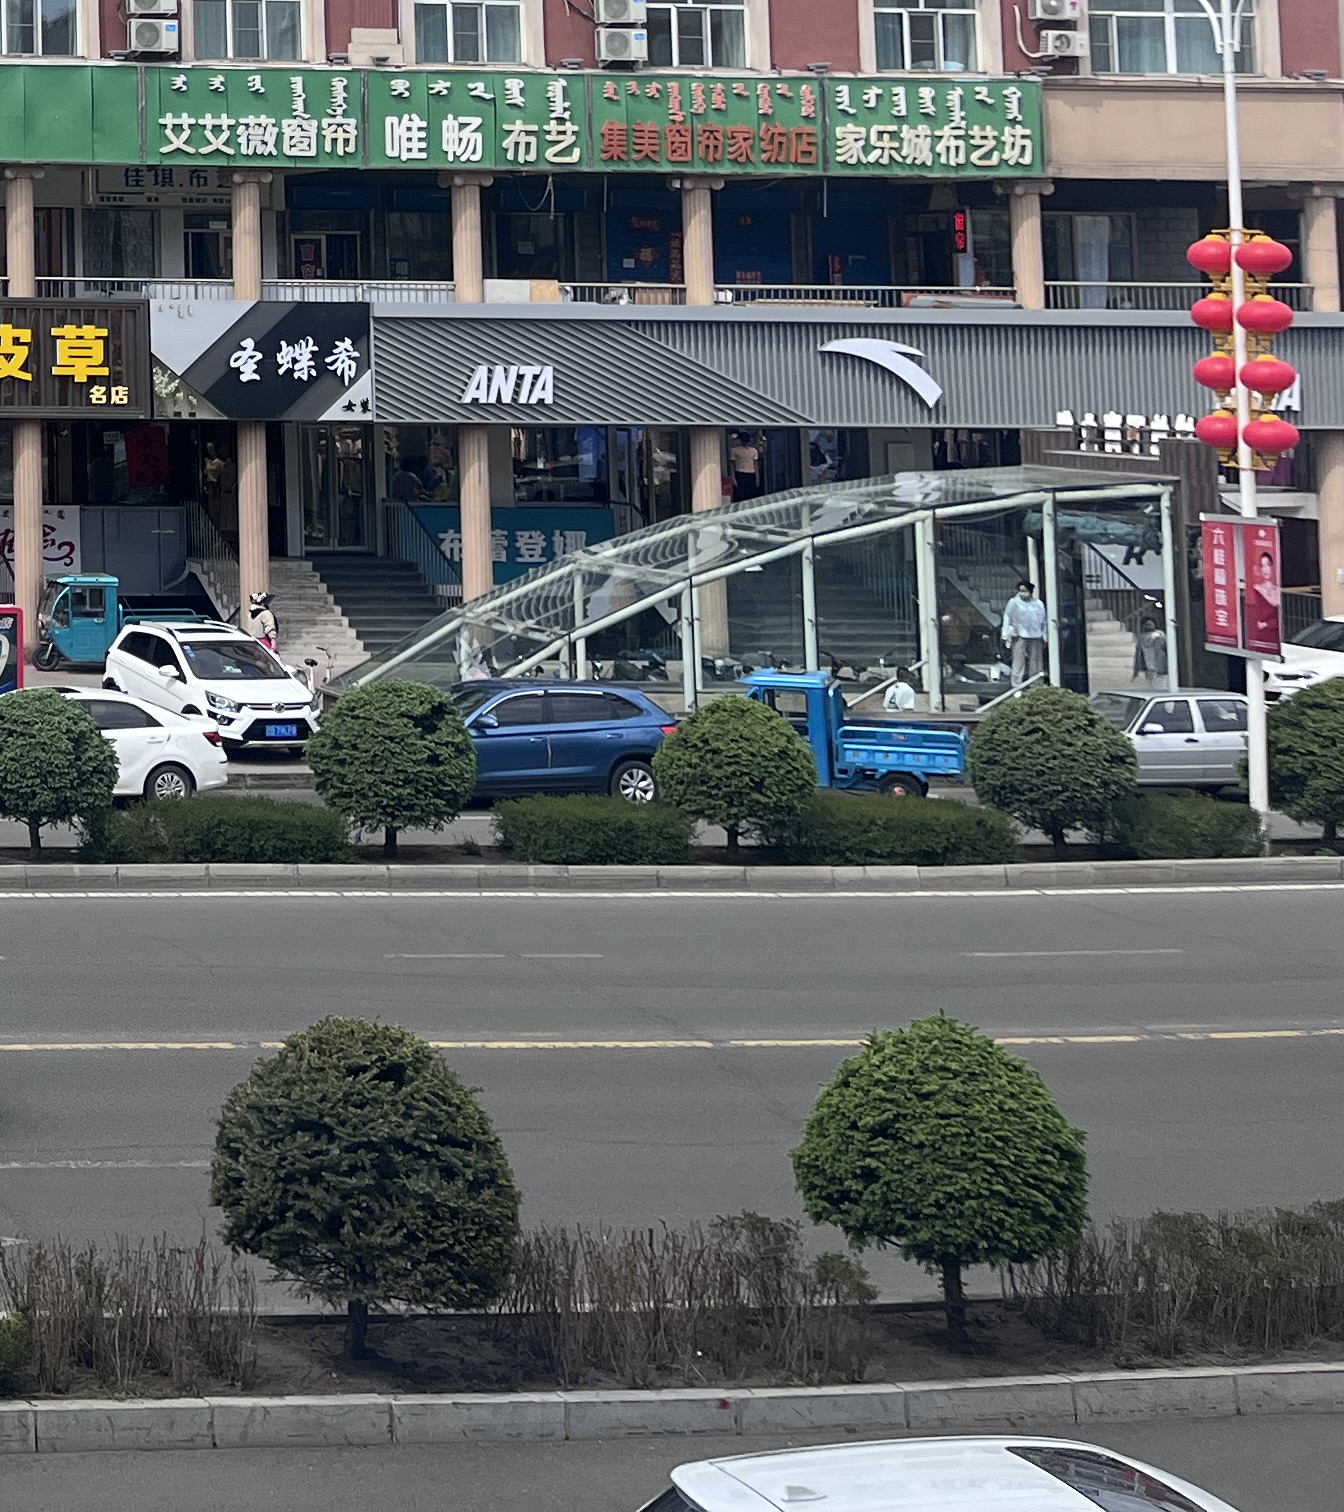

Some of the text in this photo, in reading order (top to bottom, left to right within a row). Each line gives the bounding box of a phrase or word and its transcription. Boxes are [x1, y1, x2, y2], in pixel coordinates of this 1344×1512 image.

[159, 113, 358, 157] 艾艾薇窗帘
[600, 120, 818, 164] 集美窗帘家纺店
[835, 123, 1034, 167] 家乐城布艺坊
[229, 336, 361, 387] 圣蝶希
[88, 384, 130, 405] 名店
[462, 365, 555, 405] ANTA
